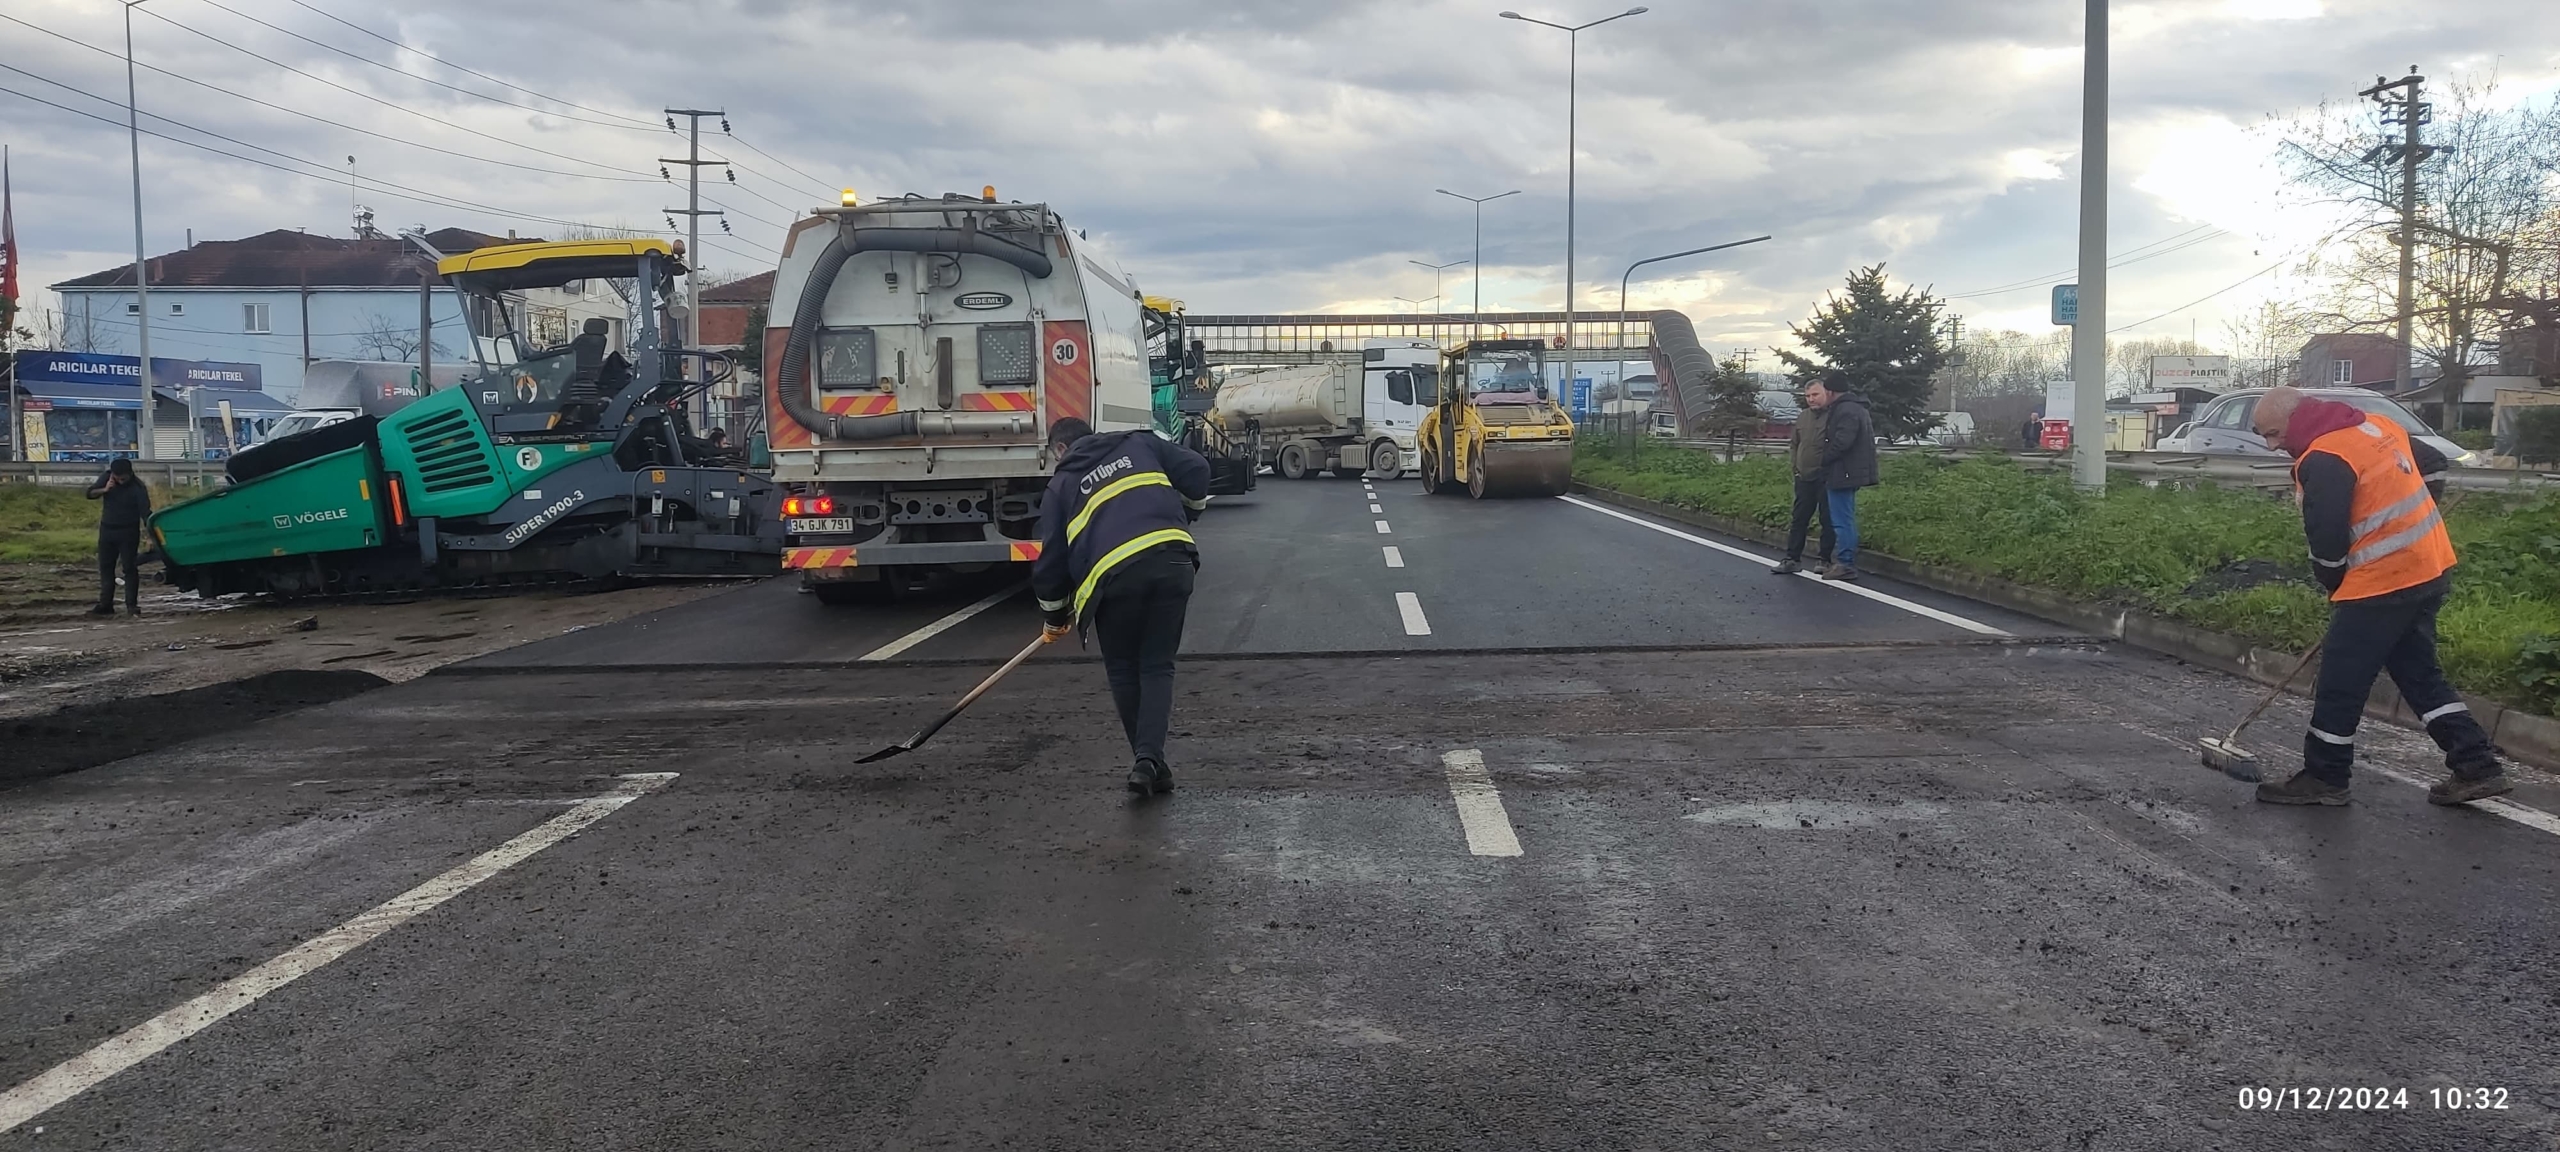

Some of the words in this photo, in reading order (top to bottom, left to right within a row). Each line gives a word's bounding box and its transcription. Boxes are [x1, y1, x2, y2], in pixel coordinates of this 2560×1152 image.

[962, 297, 1004, 305] ERDEMLI
[1056, 344, 1074, 360] 30
[49, 361, 107, 375] ARICILAR
[188, 368, 222, 381] ARICILAR
[222, 370, 244, 382] TEKEL
[1090, 455, 1134, 484] Tüpraş
[294, 508, 349, 524] VÖGELE
[505, 513, 547, 544] SUPER
[543, 489, 585, 519] 1900-3
[792, 519, 804, 531] 34
[808, 519, 827, 531] GJK
[831, 518, 849, 531] 791
